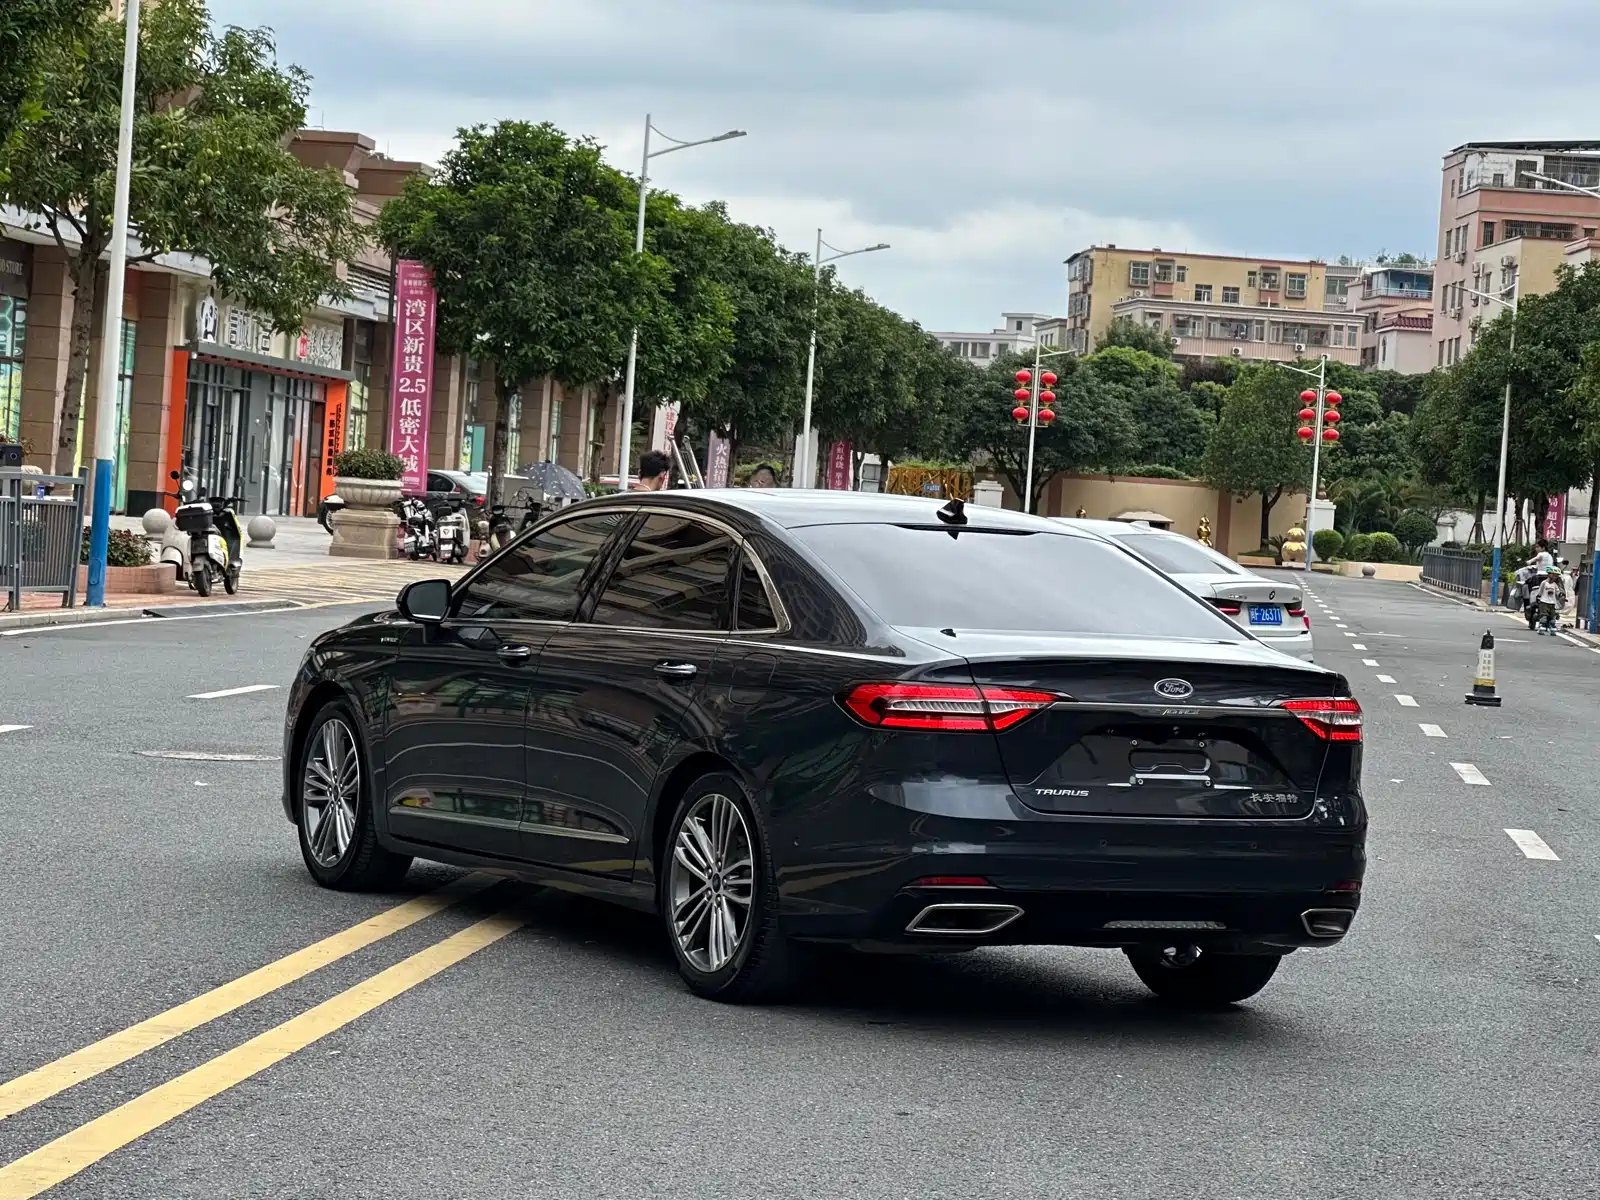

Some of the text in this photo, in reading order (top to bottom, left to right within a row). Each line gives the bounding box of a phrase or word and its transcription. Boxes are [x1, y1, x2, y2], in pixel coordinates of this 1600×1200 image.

[6, 260, 23, 276] STORE
[1163, 682, 1186, 693] Ford
[1035, 788, 1090, 797] TAURUS
[1249, 792, 1298, 804] 长安福特
